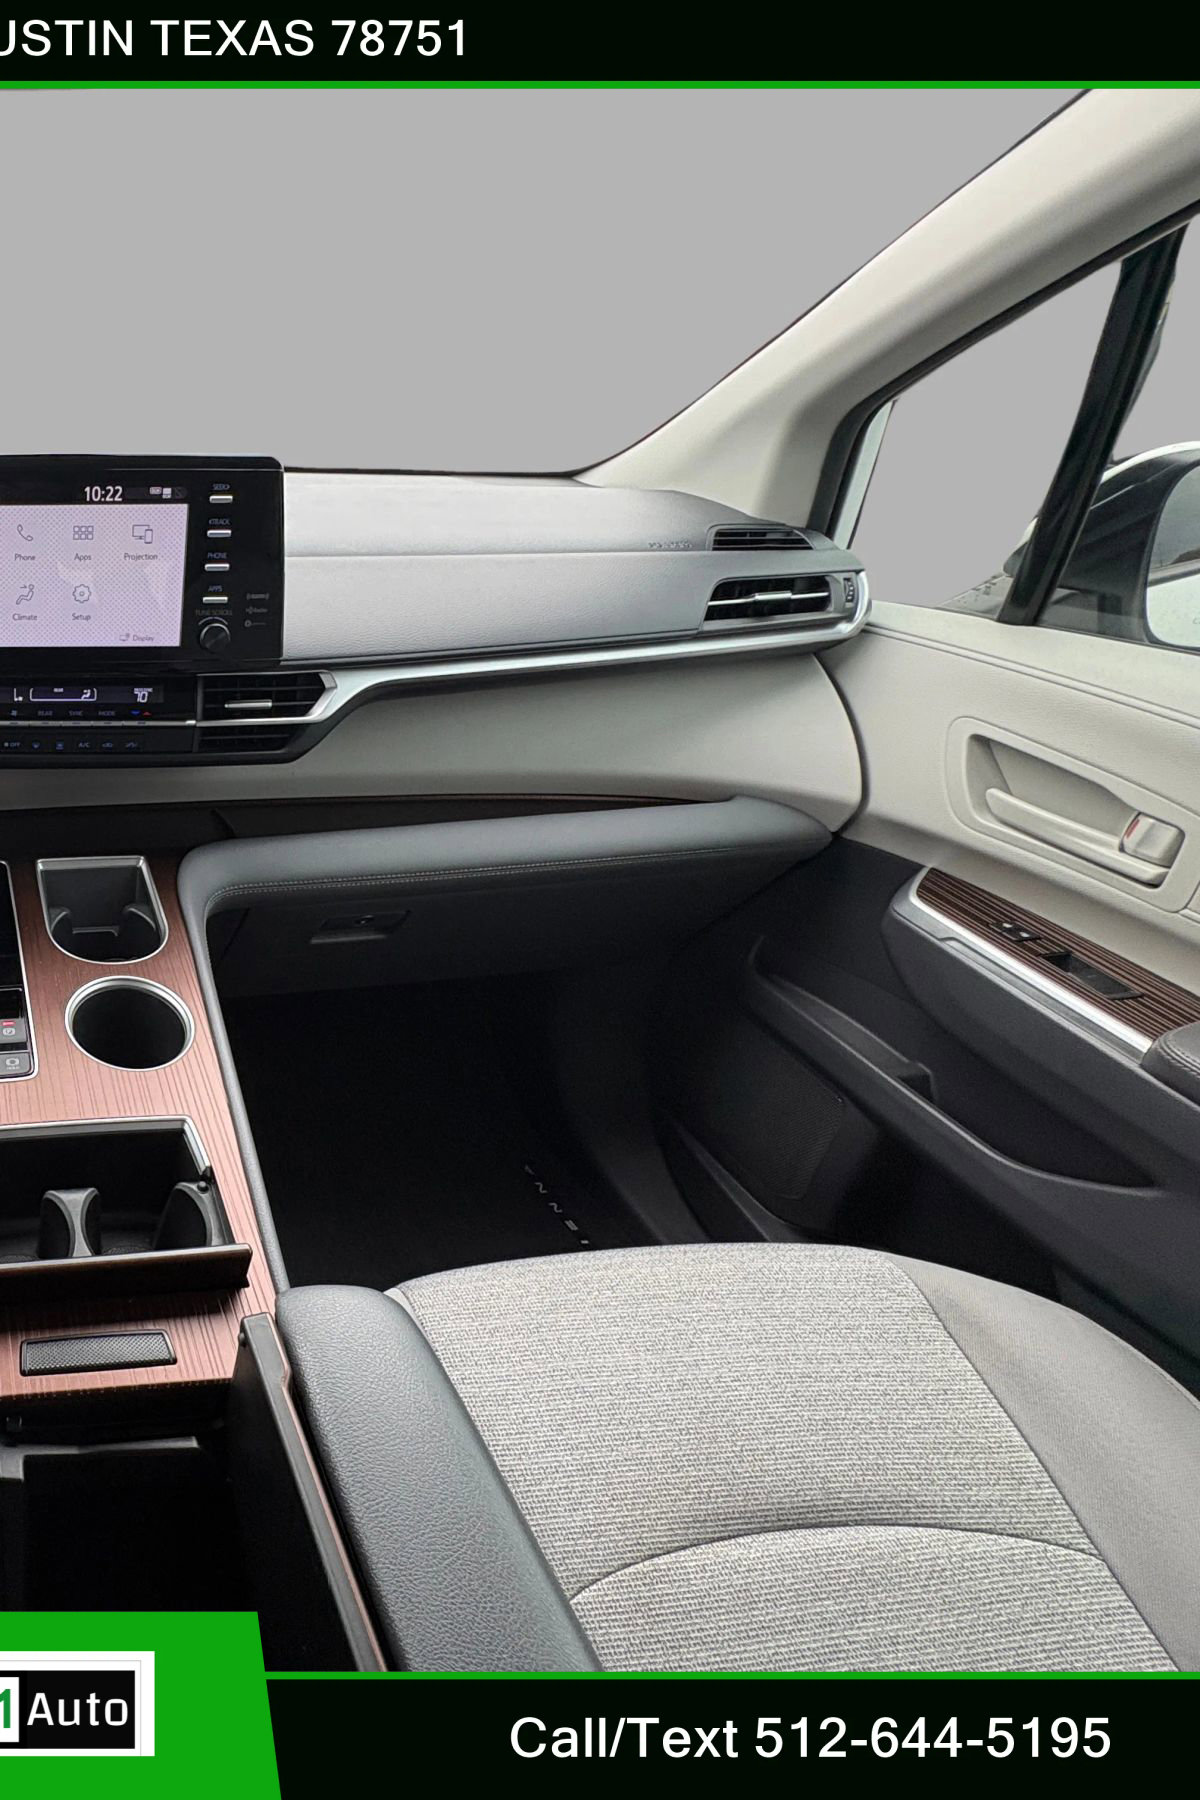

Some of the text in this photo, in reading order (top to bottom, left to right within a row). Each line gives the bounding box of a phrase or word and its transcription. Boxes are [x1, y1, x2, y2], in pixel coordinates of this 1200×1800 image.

[84, 486, 123, 502] 10:22
[14, 553, 36, 561] Phone
[74, 553, 92, 562] Apps
[124, 553, 158, 562] Projection
[12, 613, 38, 621] Climate
[72, 613, 91, 622] Setup
[132, 634, 155, 643] Display
[134, 691, 148, 703] 70
